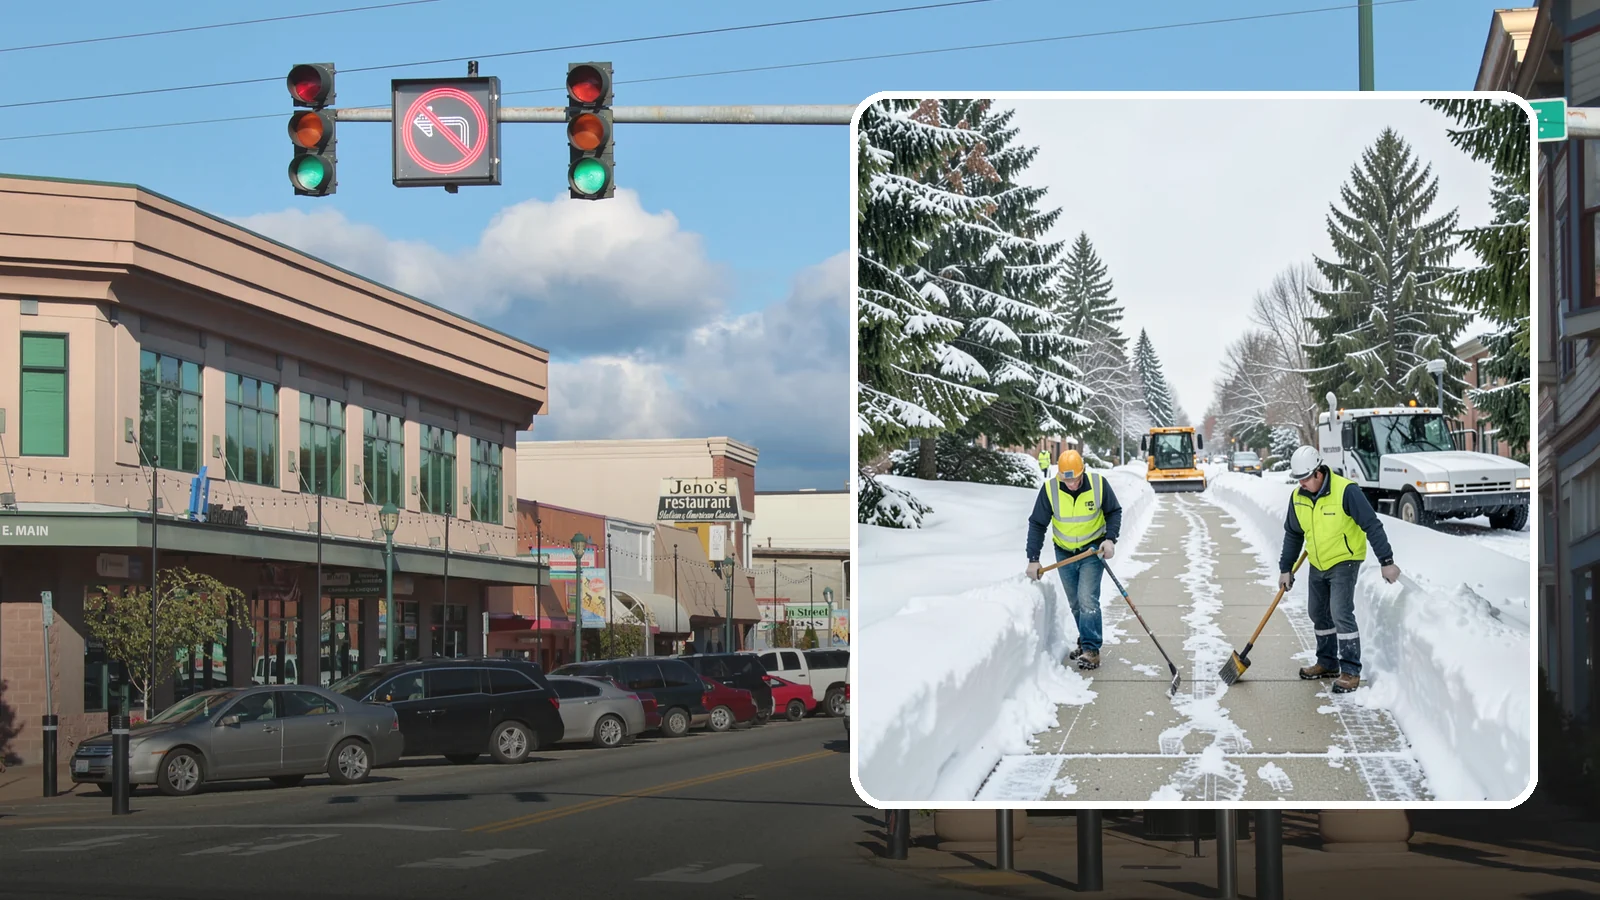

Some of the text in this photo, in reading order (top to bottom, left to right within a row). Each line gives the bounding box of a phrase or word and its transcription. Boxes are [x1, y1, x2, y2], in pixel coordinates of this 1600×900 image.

[670, 480, 728, 494] Jeno's
[665, 496, 731, 508] restaurant
[658, 510, 682, 519] Italian
[686, 510, 714, 519] American
[715, 509, 738, 519] Cuisine
[2, 525, 48, 536] E. MAIN
[798, 608, 828, 616] Street
